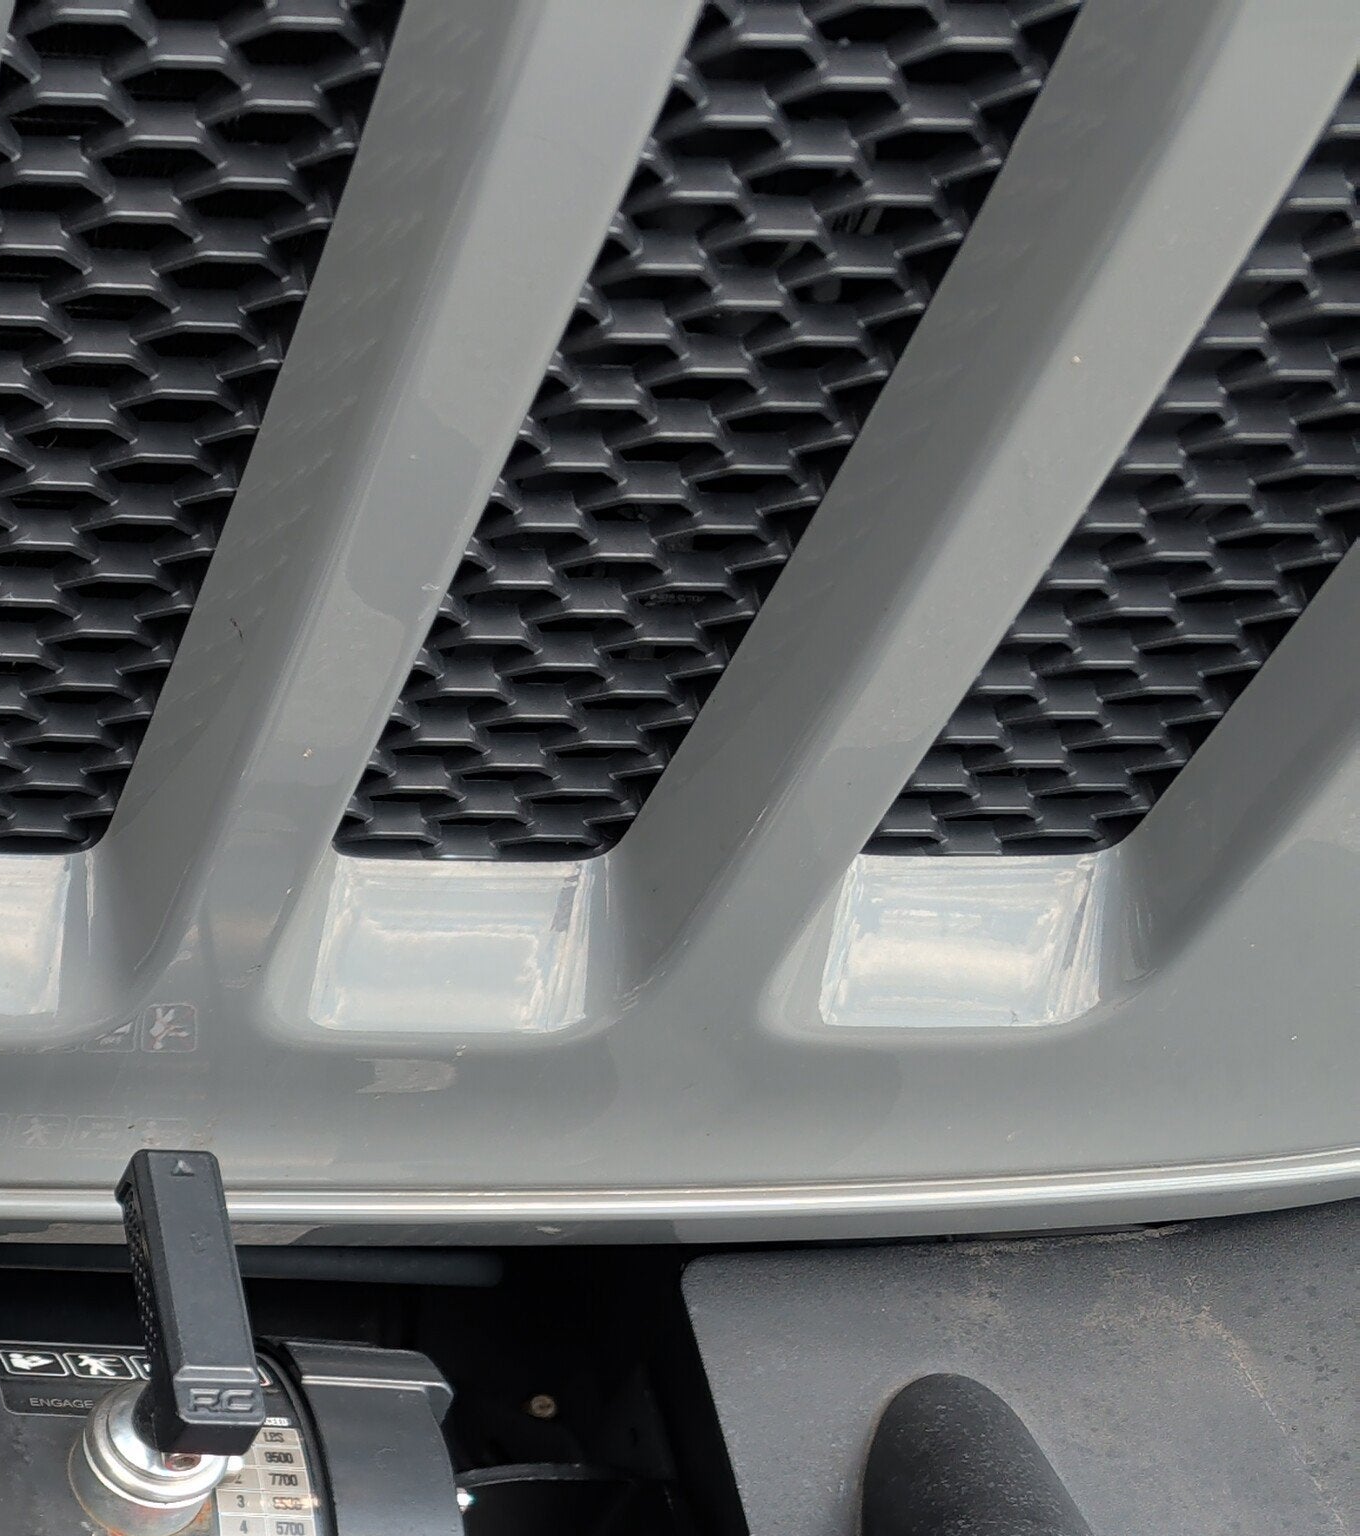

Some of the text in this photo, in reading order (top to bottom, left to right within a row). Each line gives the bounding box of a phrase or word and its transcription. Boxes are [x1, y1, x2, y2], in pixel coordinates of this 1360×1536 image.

[29, 1397, 94, 1409] ENGAGE
[187, 1388, 254, 1413] RC
[268, 1472, 299, 1487] 7700
[236, 1494, 245, 1508] 3
[240, 1520, 305, 1536] 4 5700
